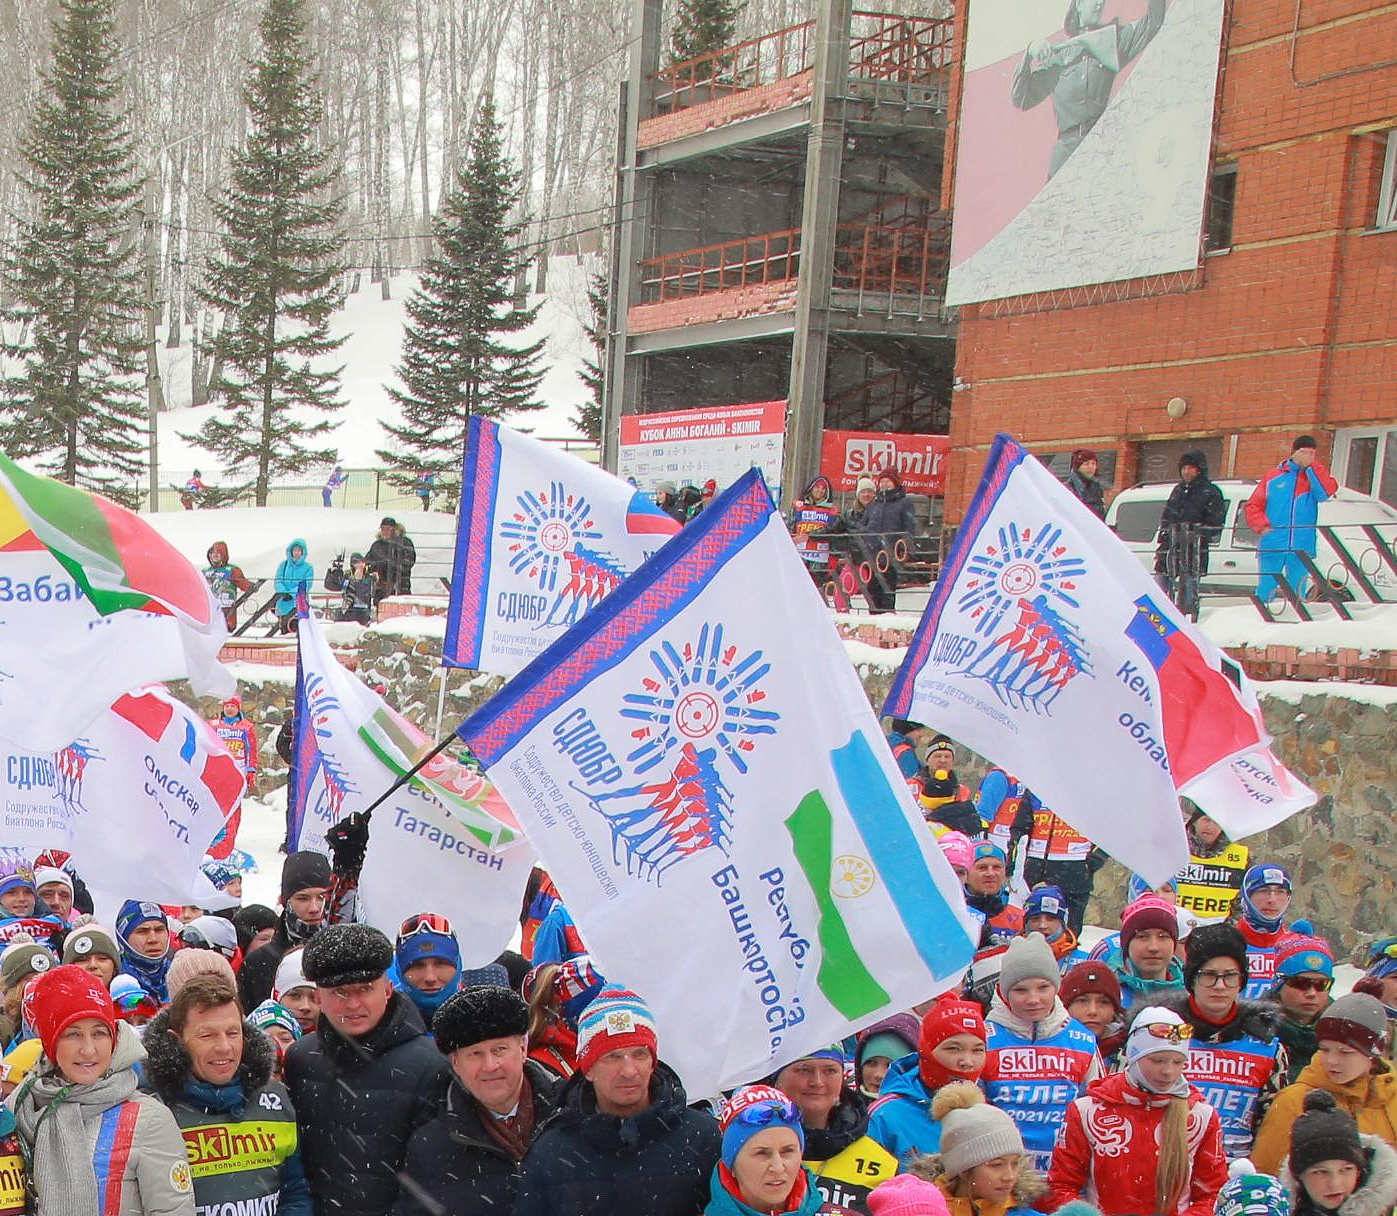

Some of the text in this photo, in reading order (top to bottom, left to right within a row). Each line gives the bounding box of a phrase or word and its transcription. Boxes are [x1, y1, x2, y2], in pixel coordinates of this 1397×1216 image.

[640, 429, 664, 442] КУБОК
[665, 426, 688, 440] АННЫ
[690, 421, 726, 437] БОГАЛИЙ
[732, 420, 761, 434] SKIMIR
[848, 443, 943, 476] skimir
[497, 591, 548, 623] СДЮБР
[552, 706, 623, 787] СДЮБР
[6, 754, 55, 791] СДЮБ
[393, 806, 505, 871] Татарстан
[1227, 853, 1241, 862] 85
[1177, 865, 1233, 882] skimir
[1177, 896, 1230, 913] FERE
[710, 863, 788, 1053] Башкортоста
[1000, 1048, 1076, 1073] skimir
[259, 1093, 283, 1111] 42
[721, 1086, 791, 1124] DEMIN
[993, 1084, 1070, 1107] АТЛЕ
[1201, 1086, 1259, 1115] ЛЕТ
[855, 1158, 881, 1176] 15
